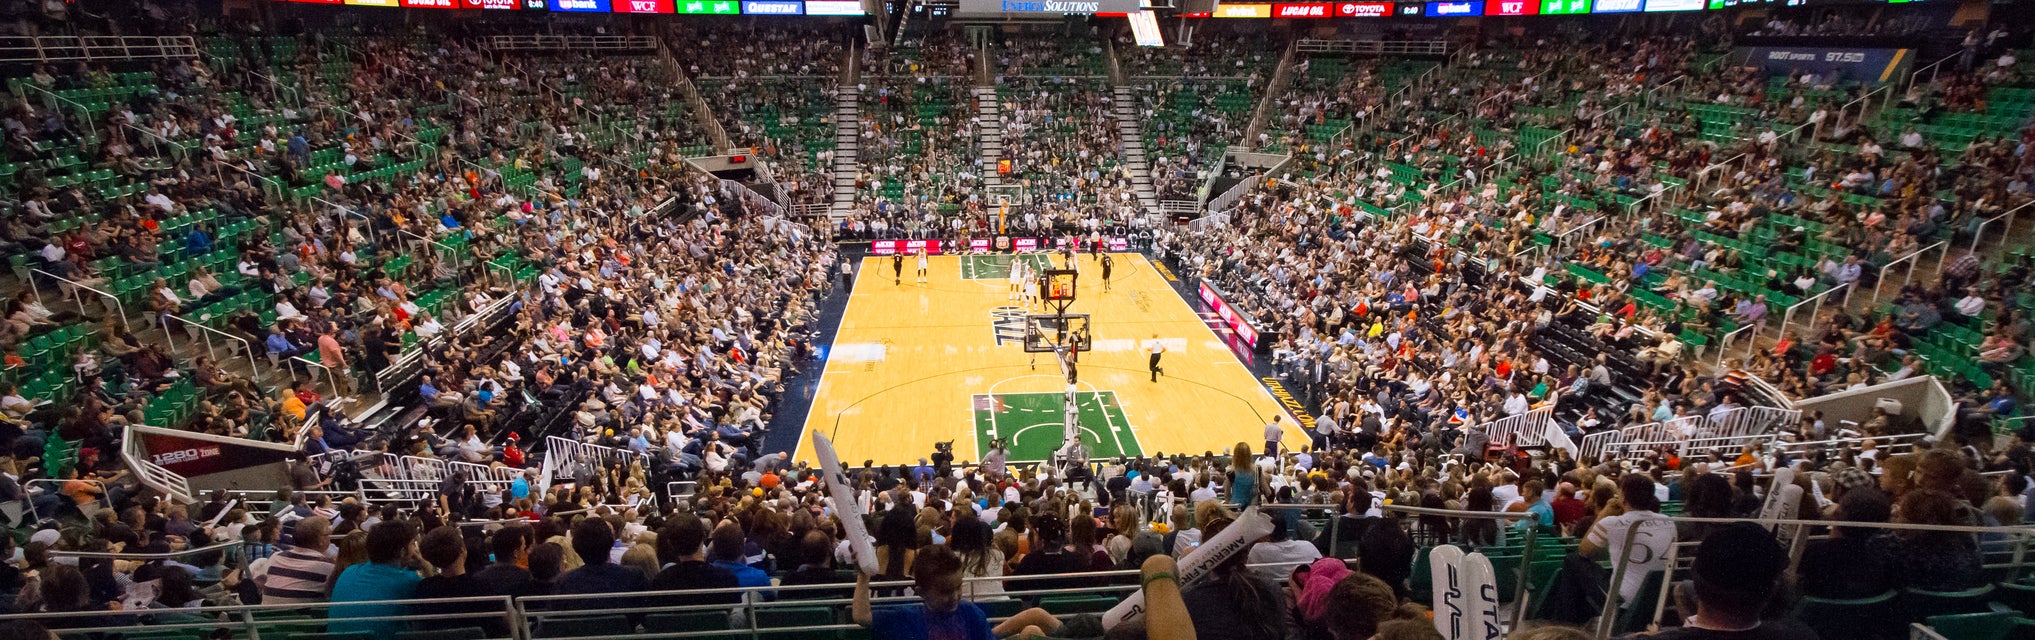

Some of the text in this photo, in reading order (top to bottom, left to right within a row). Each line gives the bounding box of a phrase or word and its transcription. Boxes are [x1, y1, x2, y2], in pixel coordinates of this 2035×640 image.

[631, 1, 656, 11] WCF
[748, 2, 797, 13] QUESTAR
[1281, 6, 1324, 15] LUCAS OIL
[1354, 5, 1385, 13] TOYOTA
[1501, 2, 1523, 13] WCF
[153, 447, 220, 463] 1280 ZONE
[1199, 536, 1246, 571] AMERICA
